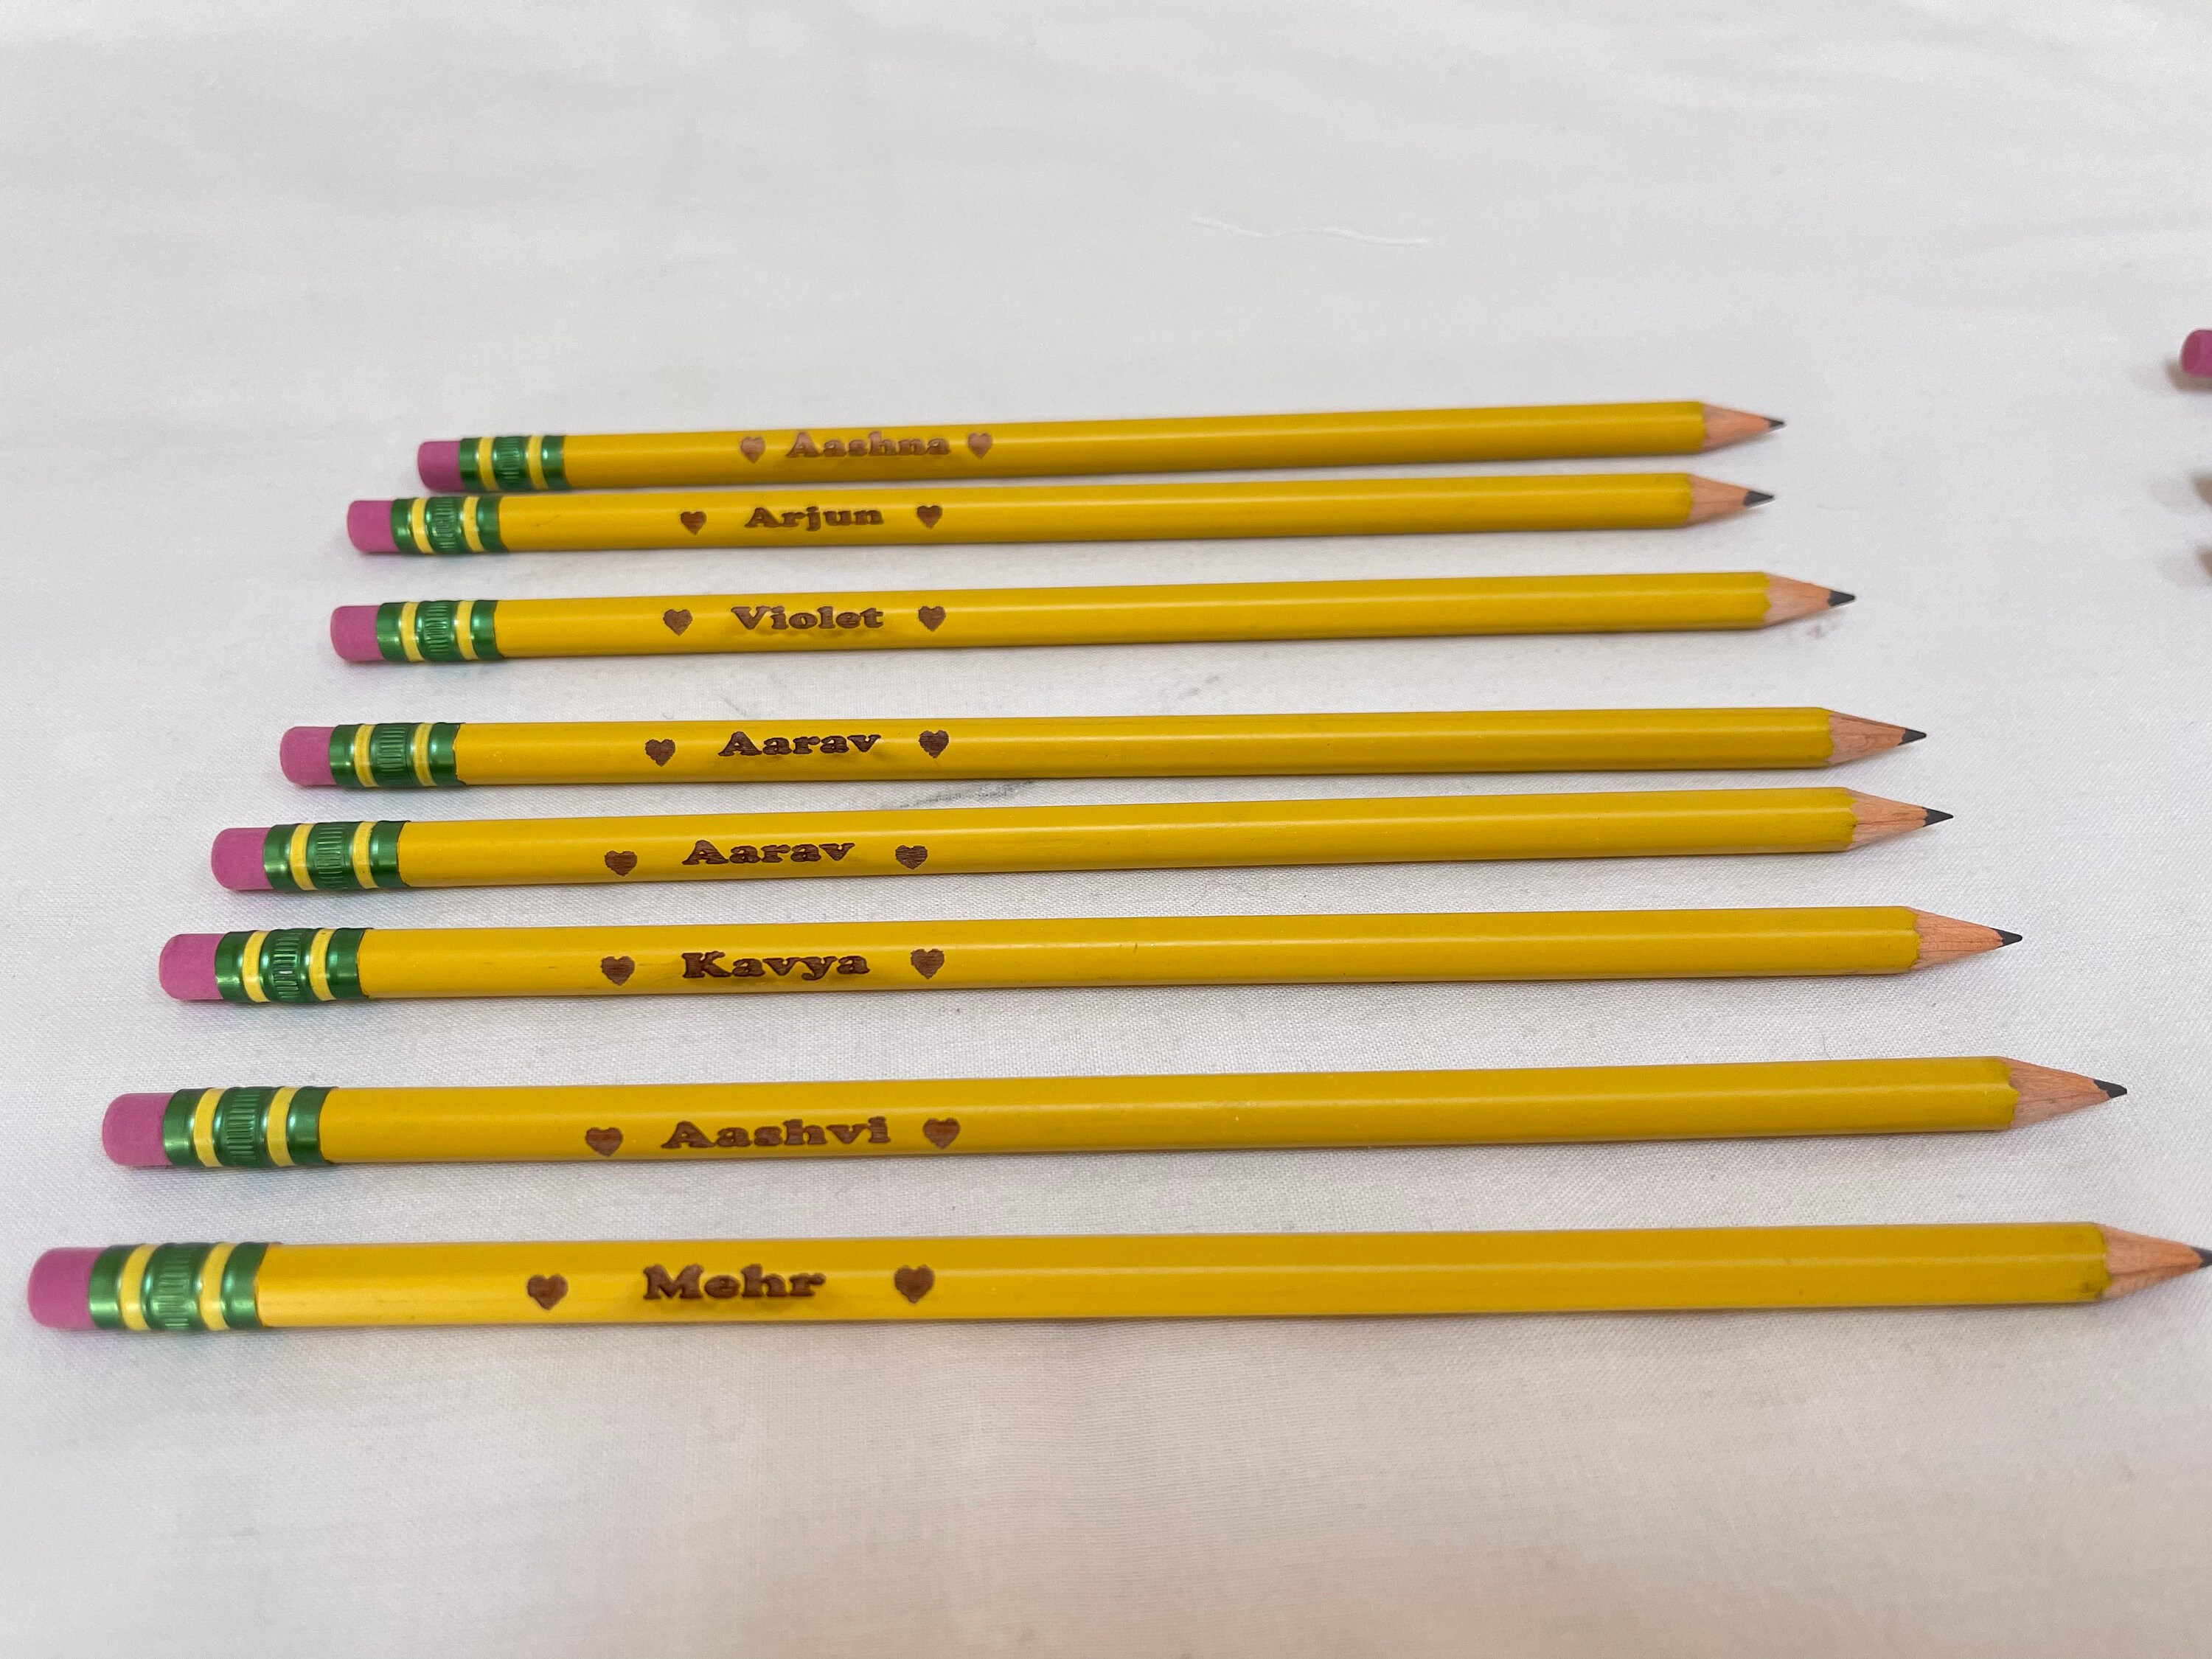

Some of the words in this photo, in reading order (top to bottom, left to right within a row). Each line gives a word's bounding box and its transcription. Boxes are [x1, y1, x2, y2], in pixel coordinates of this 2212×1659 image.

[785, 432, 950, 459] Aashna
[744, 505, 883, 531] Arjun
[731, 606, 883, 630] Violet
[718, 731, 881, 757] Aarav
[682, 841, 855, 866] Aarav
[681, 951, 870, 981] Kavya
[661, 1117, 891, 1149] Aashvi
[643, 1265, 825, 1301] Mehr
